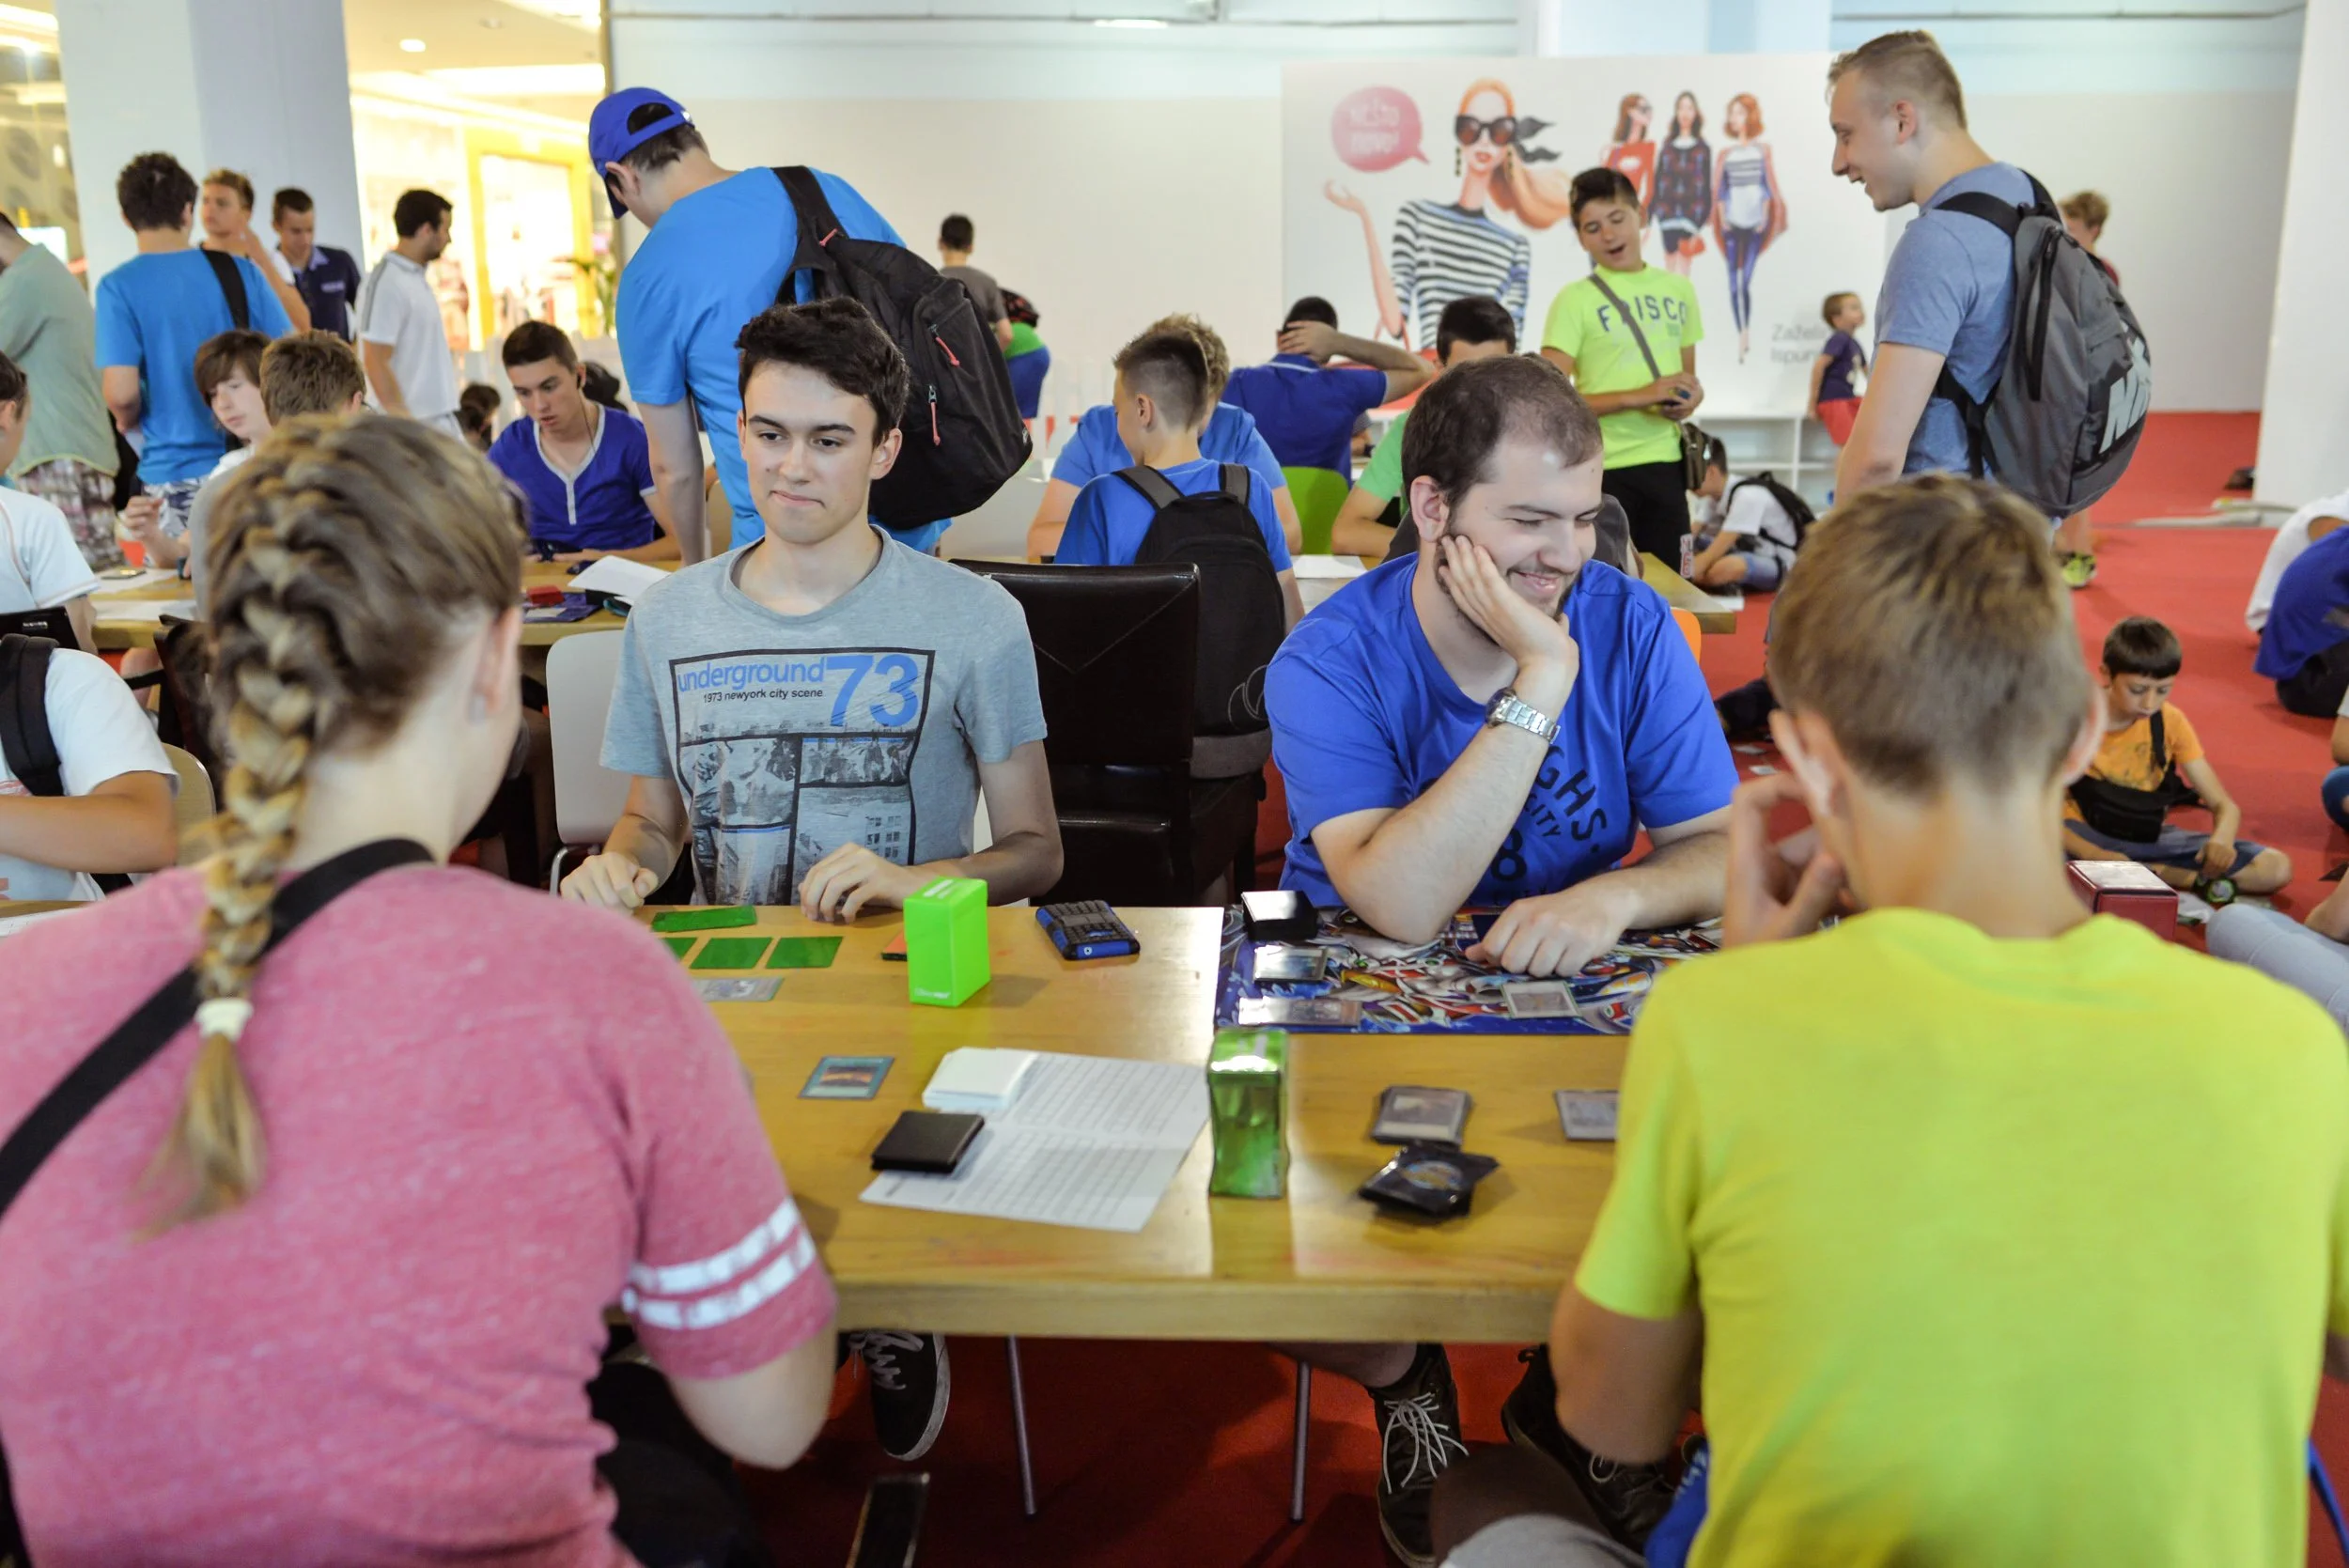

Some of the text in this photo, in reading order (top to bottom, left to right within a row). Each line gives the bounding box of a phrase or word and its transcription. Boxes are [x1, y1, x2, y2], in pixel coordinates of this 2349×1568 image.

[677, 653, 920, 727] underground 73
[704, 687, 823, 703] 1973 newyork city scene
